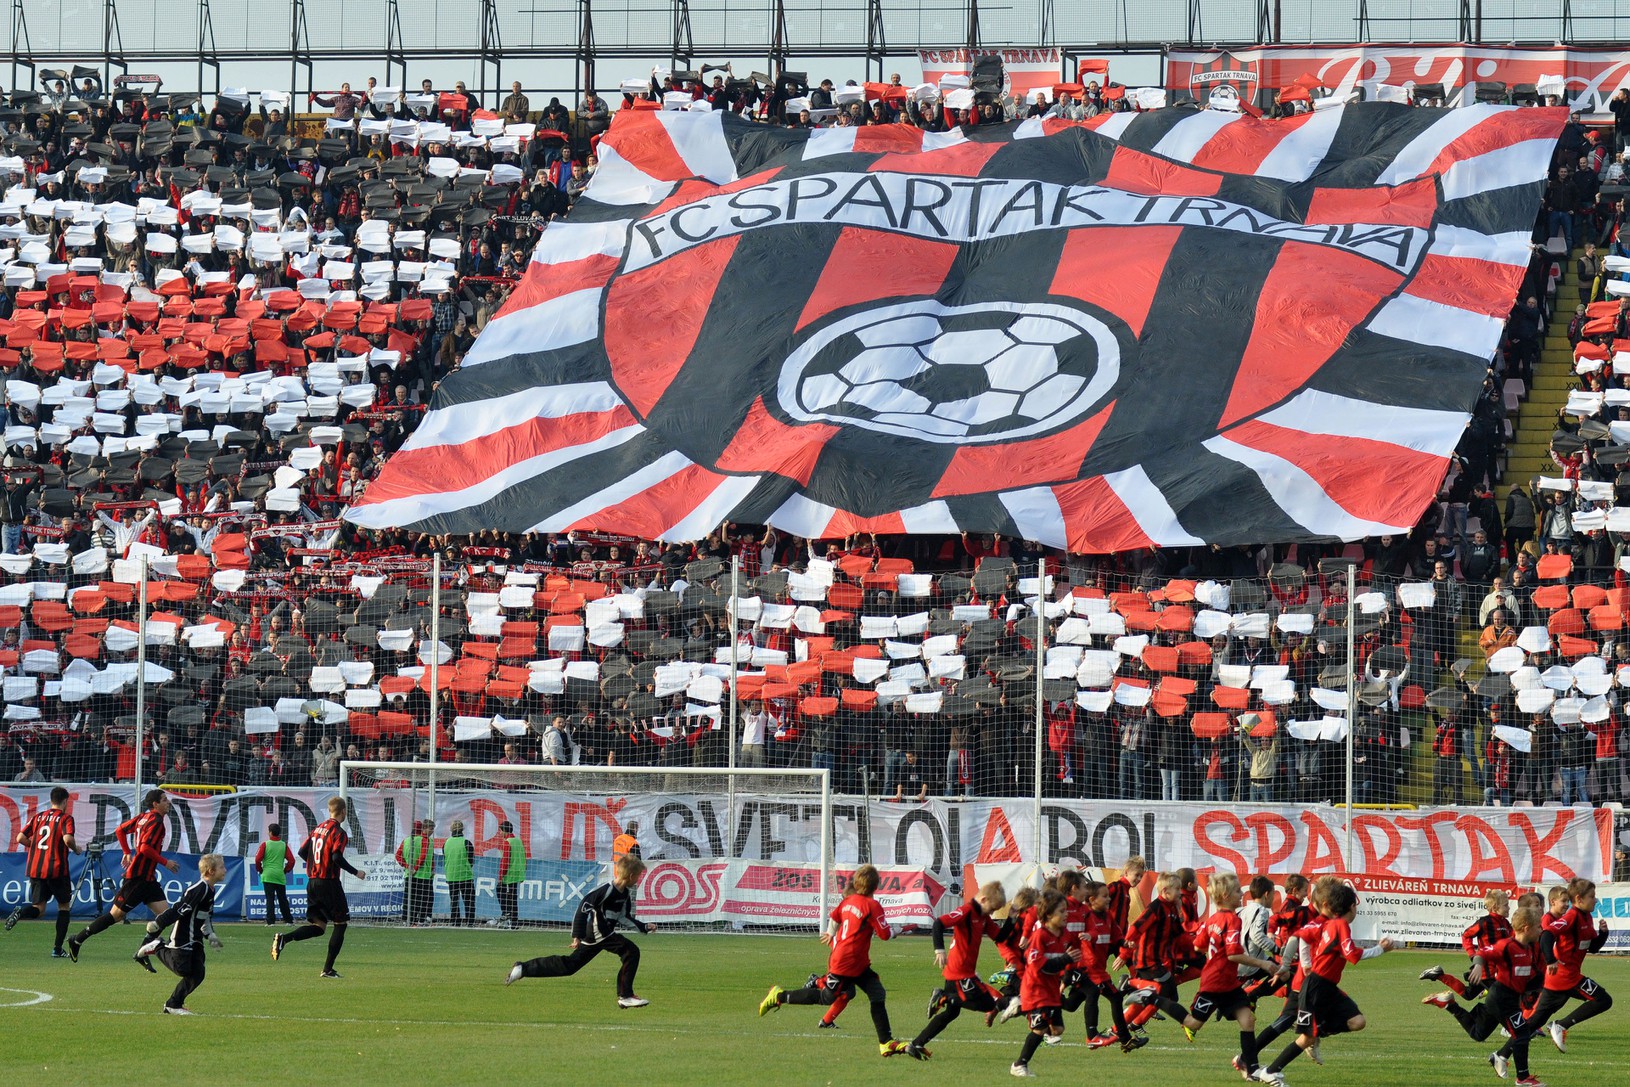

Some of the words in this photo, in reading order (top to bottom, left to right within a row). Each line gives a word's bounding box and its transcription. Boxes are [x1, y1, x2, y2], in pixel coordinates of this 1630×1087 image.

[920, 49, 938, 63] FC
[1002, 48, 1060, 64] TRNAVA
[1203, 72, 1231, 81] SPARTAK
[1233, 72, 1256, 80] TRNAVA
[635, 203, 717, 258] FC
[728, 173, 1109, 238] SPARTAK
[38, 825, 50, 849] 2
[976, 807, 1022, 863] A
[311, 837, 324, 864] 18
[771, 868, 812, 888] ŽOS
[1364, 878, 1429, 893] ZLIEVÁREŇ
[1433, 882, 1481, 895] TRNAVA
[878, 896, 903, 904] Trnava
[1365, 896, 1400, 906] výrobca
[1402, 897, 1443, 908] odliatkov
[1457, 901, 1477, 911] sivej
[740, 905, 768, 914] oprava
